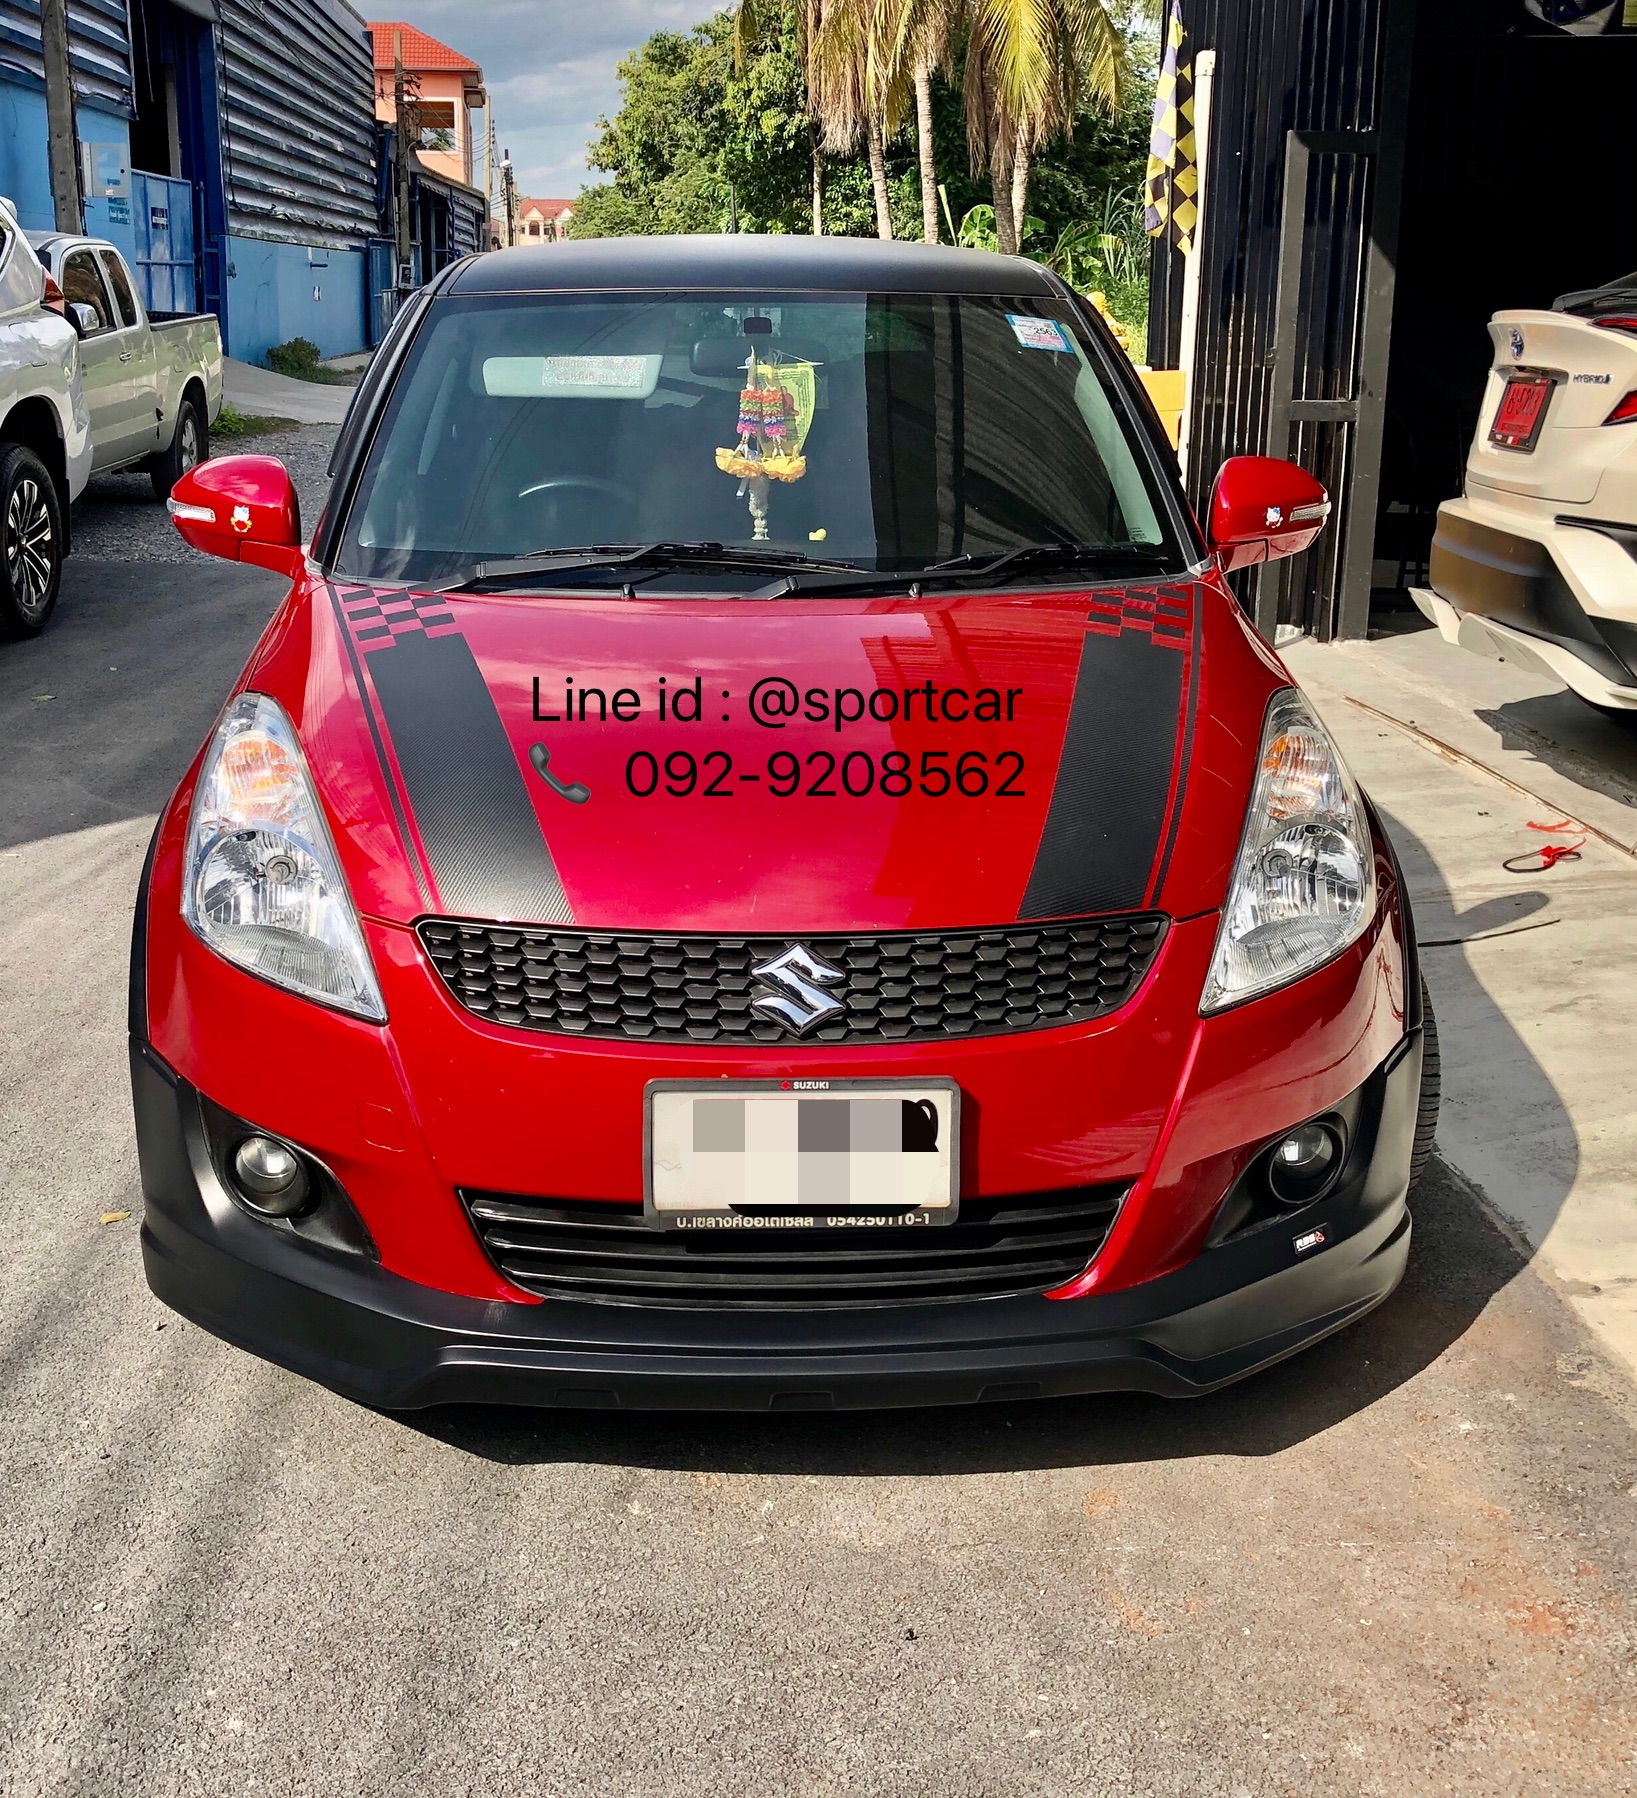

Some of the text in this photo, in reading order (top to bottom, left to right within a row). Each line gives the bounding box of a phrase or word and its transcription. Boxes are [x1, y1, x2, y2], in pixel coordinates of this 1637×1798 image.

[1033, 327, 1058, 336] 2563
[1572, 373, 1604, 384] HYBRID
[792, 1081, 829, 1090] SUZUKI
